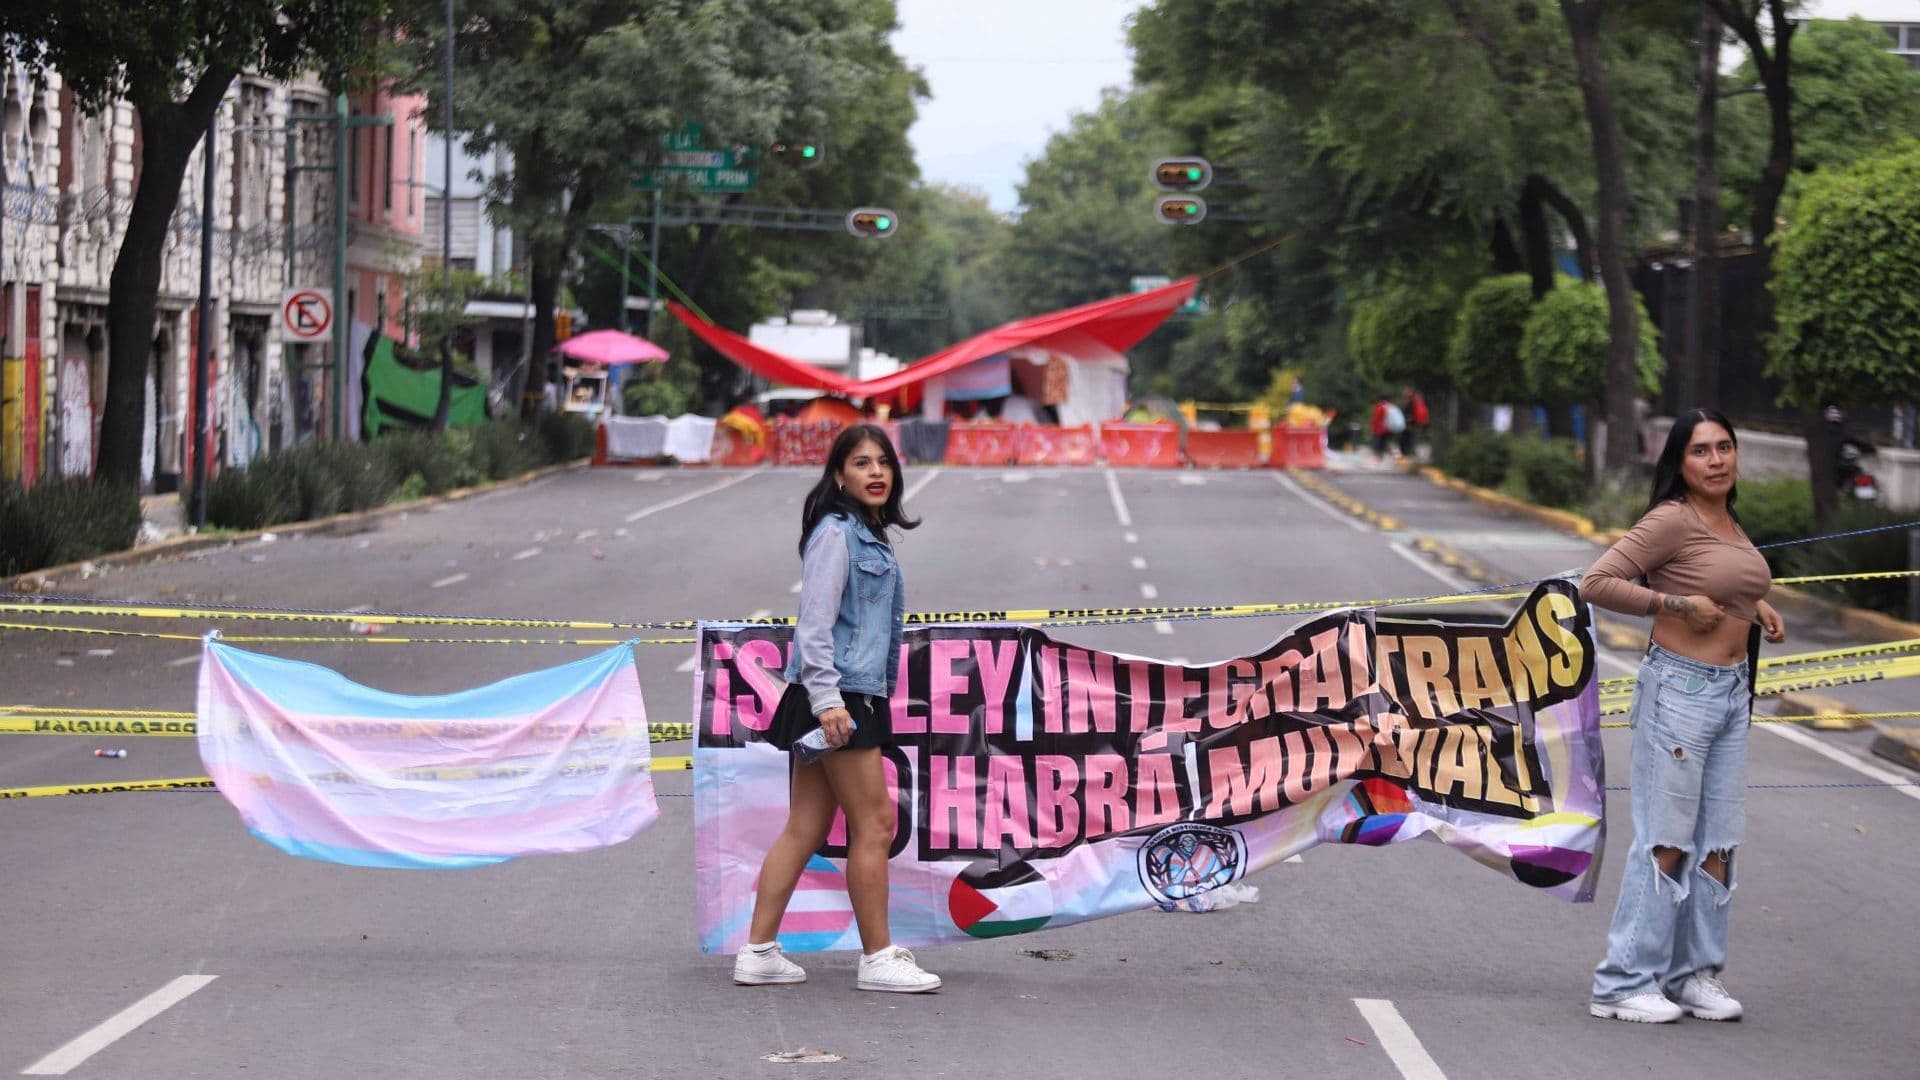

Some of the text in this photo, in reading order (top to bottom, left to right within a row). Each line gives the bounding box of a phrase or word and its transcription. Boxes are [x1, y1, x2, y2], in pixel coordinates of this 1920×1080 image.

[889, 639, 1018, 734] LEY
[1041, 622, 1379, 734] INTEGRAL
[1376, 593, 1584, 720] TRANS
[930, 731, 1181, 850] HABRÁ
